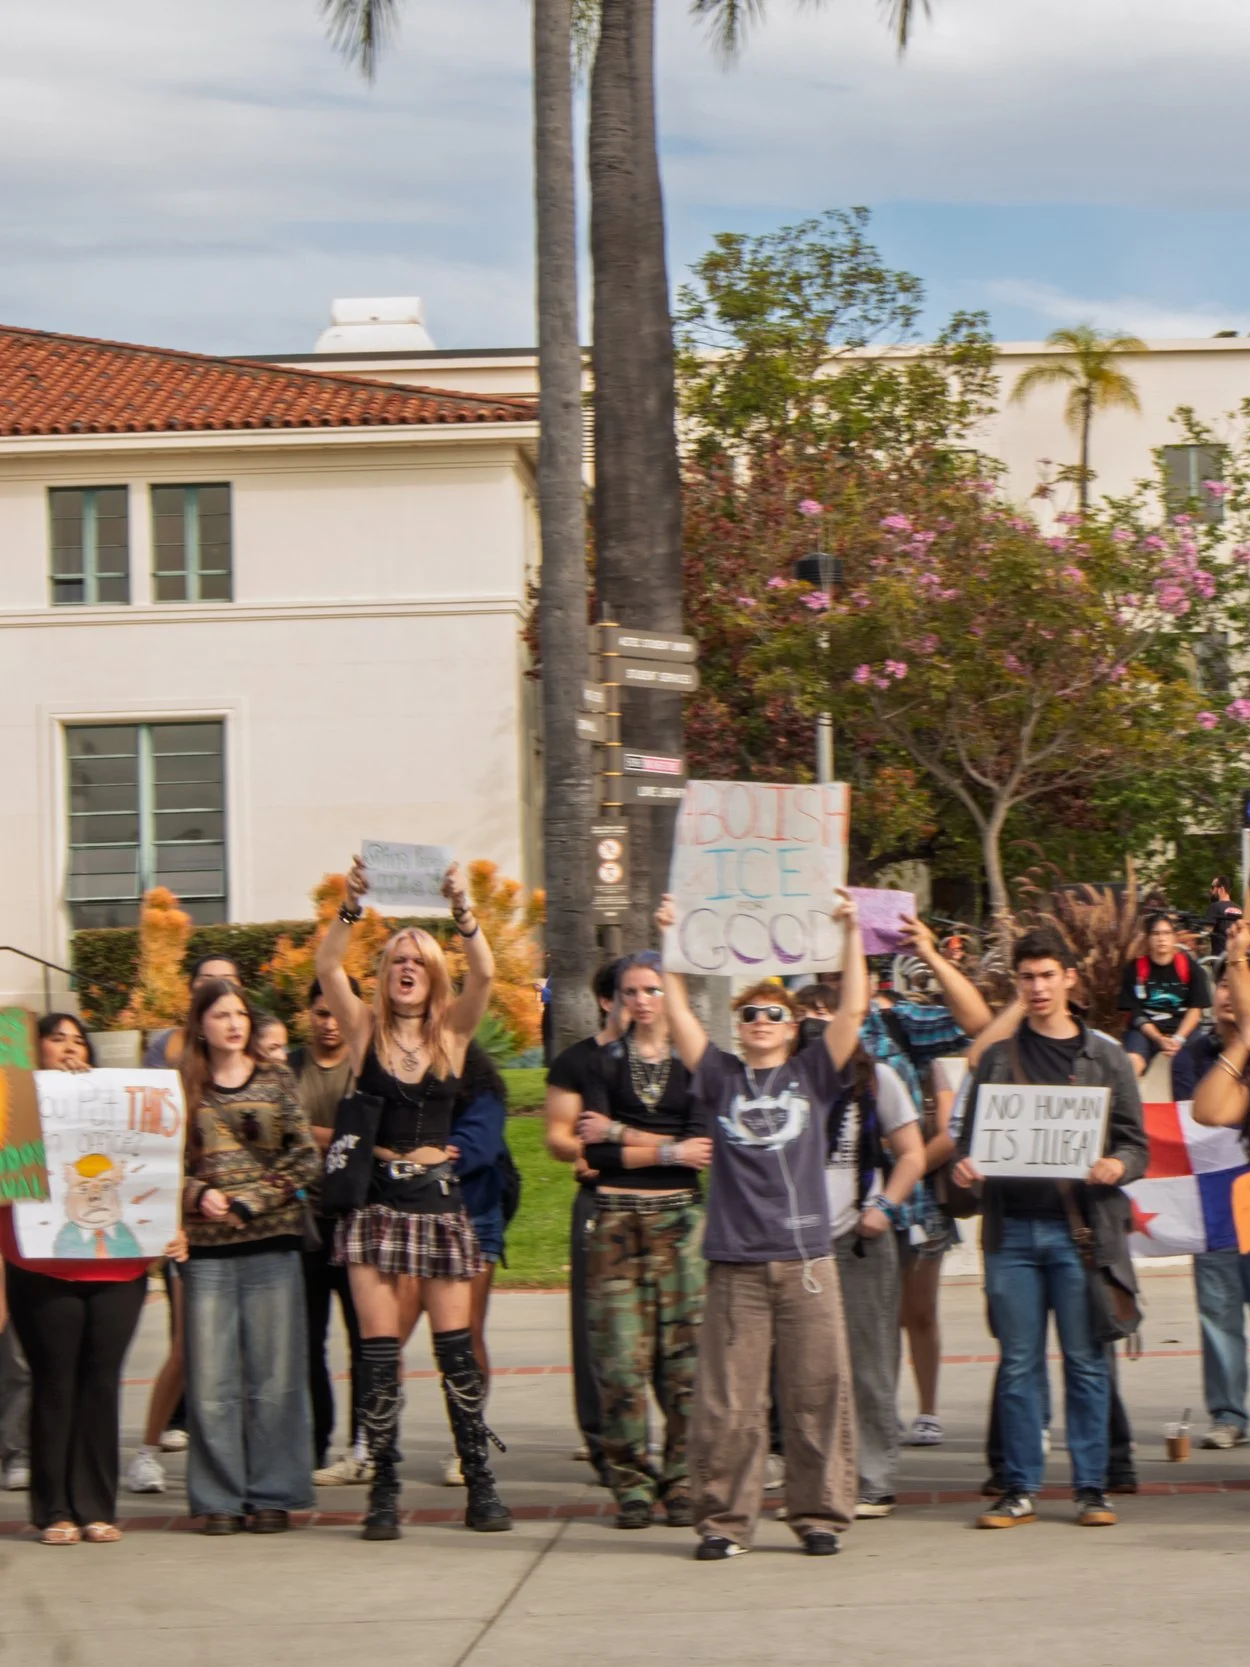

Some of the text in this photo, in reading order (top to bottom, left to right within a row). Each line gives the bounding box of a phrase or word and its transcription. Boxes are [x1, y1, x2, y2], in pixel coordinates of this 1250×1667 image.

[703, 848, 812, 900] ICE
[679, 908, 846, 970] GOOD
[984, 1093, 1104, 1121] NO HUMAN
[978, 1128, 1019, 1163] IS
